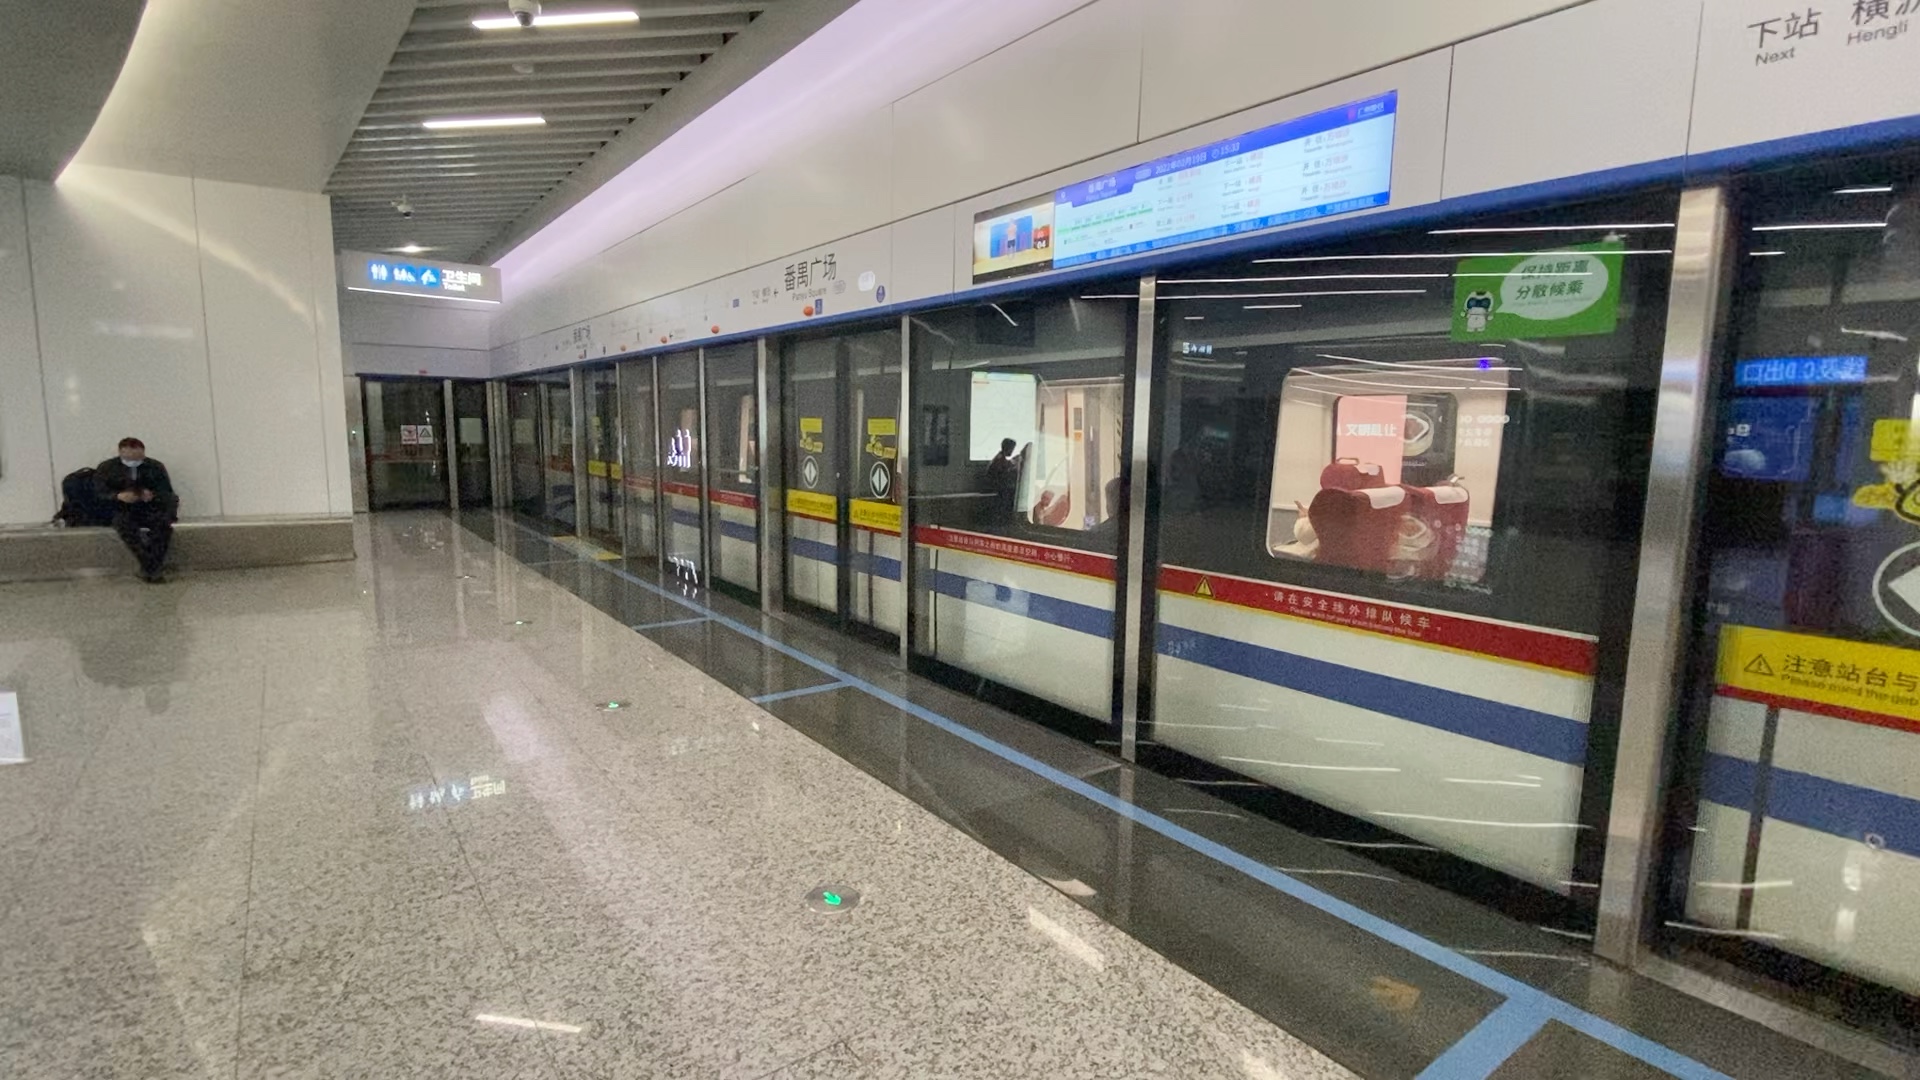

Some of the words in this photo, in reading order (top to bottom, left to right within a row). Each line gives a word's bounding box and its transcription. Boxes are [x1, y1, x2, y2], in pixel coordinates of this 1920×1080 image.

[1747, 7, 1822, 49] 下站
[1847, 20, 1908, 46] Hengli
[1755, 47, 1795, 66] Next
[441, 269, 482, 286] 卫生间
[784, 253, 837, 292] 番禺广场
[1515, 280, 1585, 301] 分散候乘
[1783, 654, 1920, 692] 注意站台与
